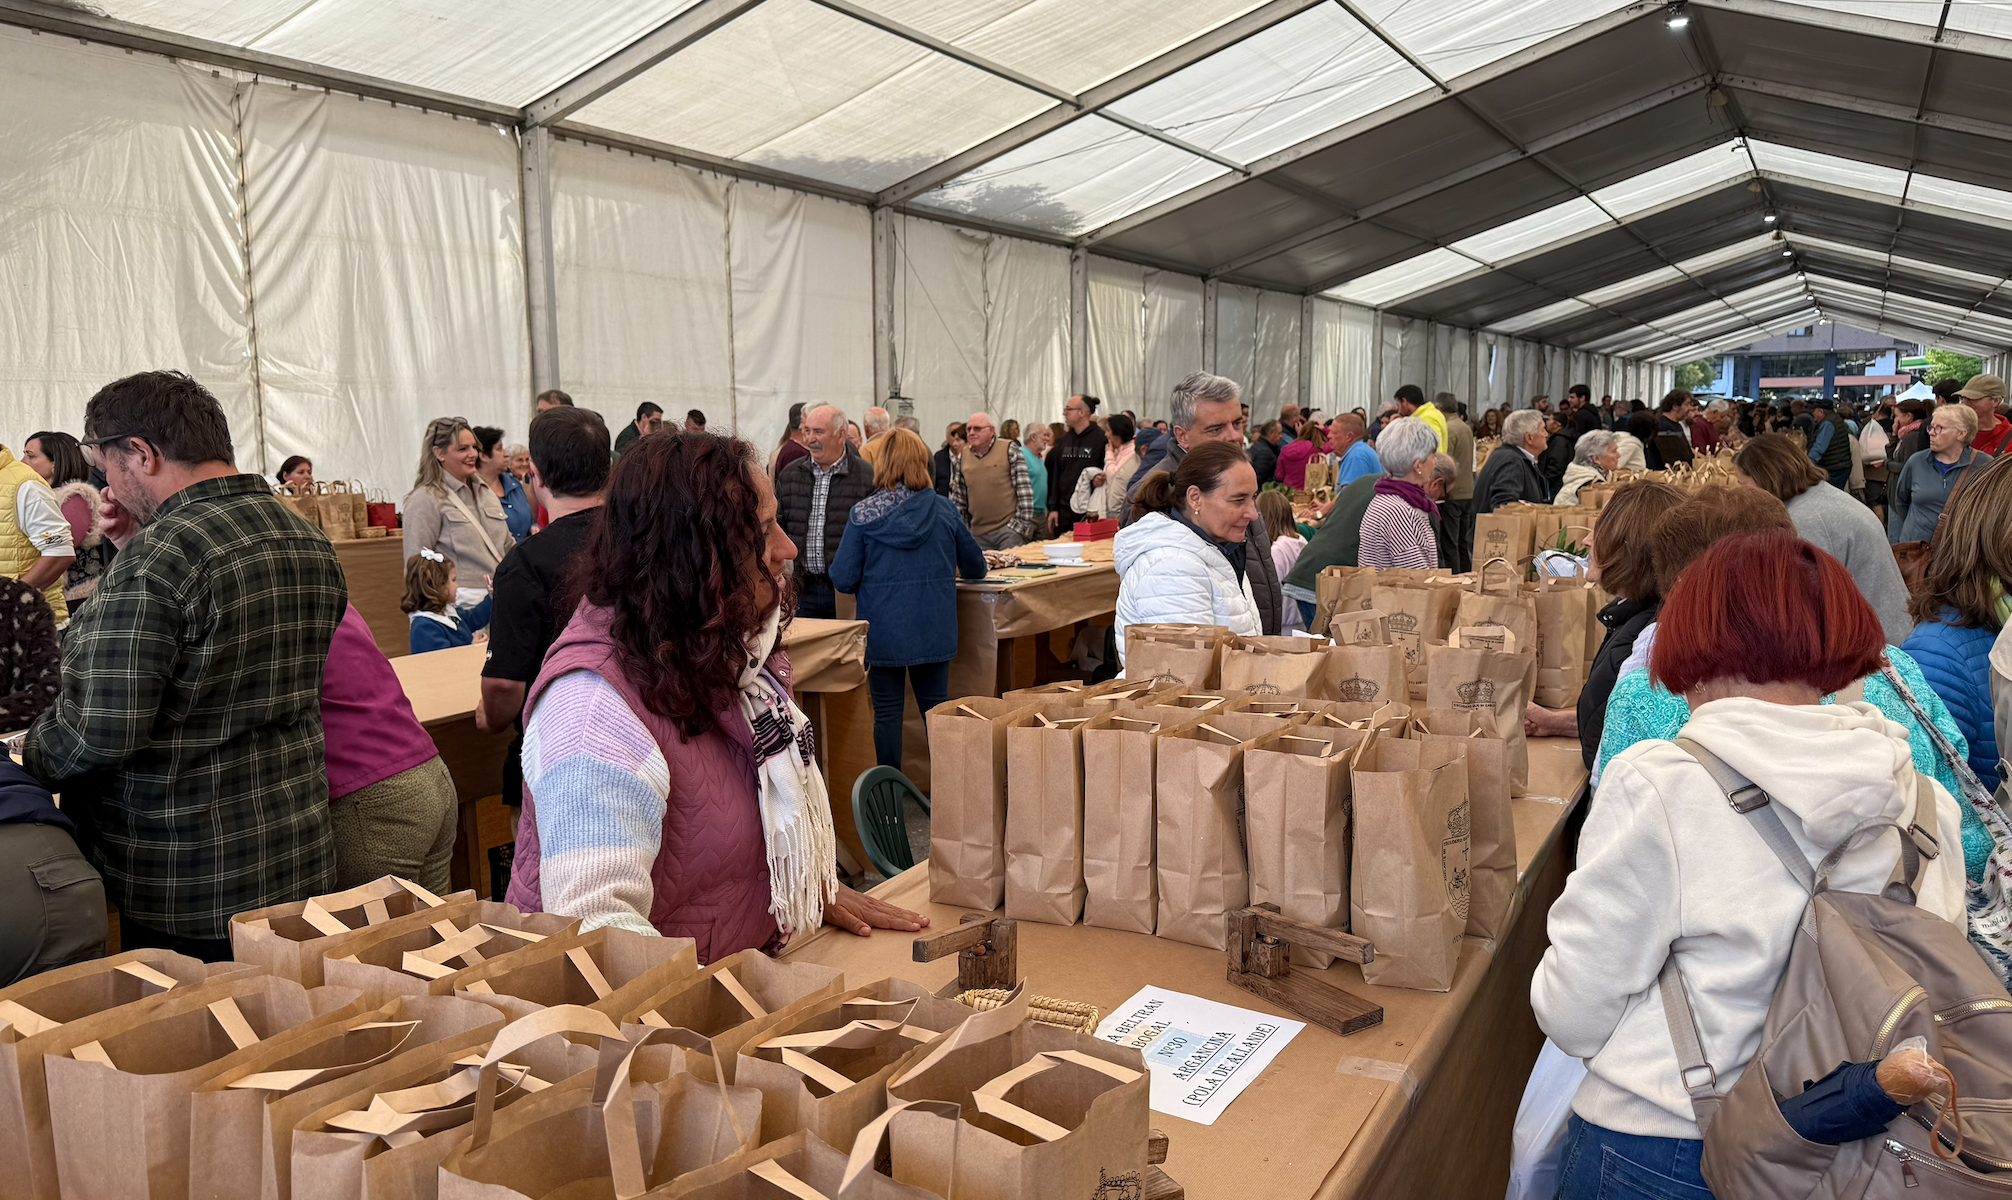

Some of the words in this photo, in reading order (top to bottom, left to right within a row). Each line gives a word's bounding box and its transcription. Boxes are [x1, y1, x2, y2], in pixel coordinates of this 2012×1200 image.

[1115, 999, 1165, 1034] BELTRAN
[1131, 1021, 1172, 1048] BOGAL
[1172, 1032, 1233, 1081] ARGANCINA
[1182, 1078, 1224, 1106] (POLA
[1212, 1063, 1235, 1077] DE
